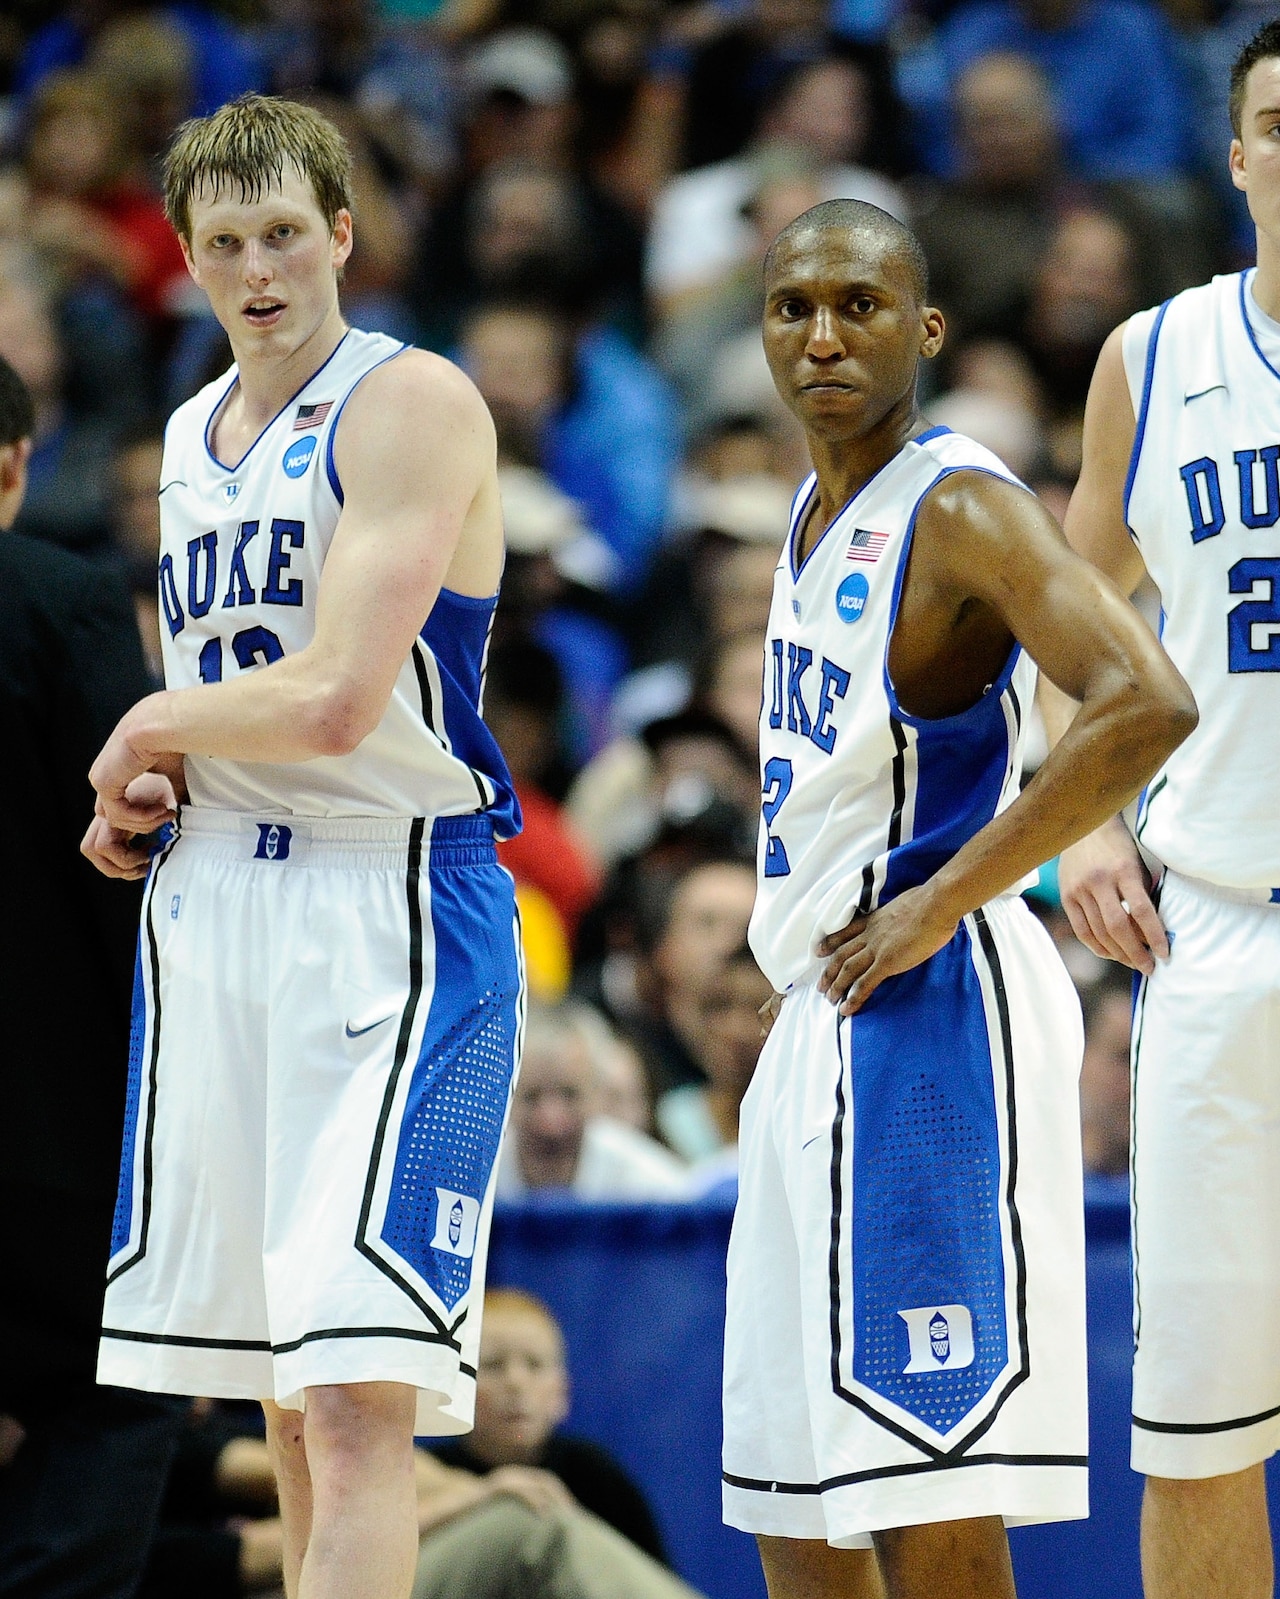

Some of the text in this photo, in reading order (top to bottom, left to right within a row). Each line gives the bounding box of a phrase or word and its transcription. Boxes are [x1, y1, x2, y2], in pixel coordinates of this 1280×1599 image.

[159, 517, 305, 642] DUKE
[839, 594, 866, 611] NCAA
[765, 638, 852, 757] UKE
[761, 756, 794, 878] 2
